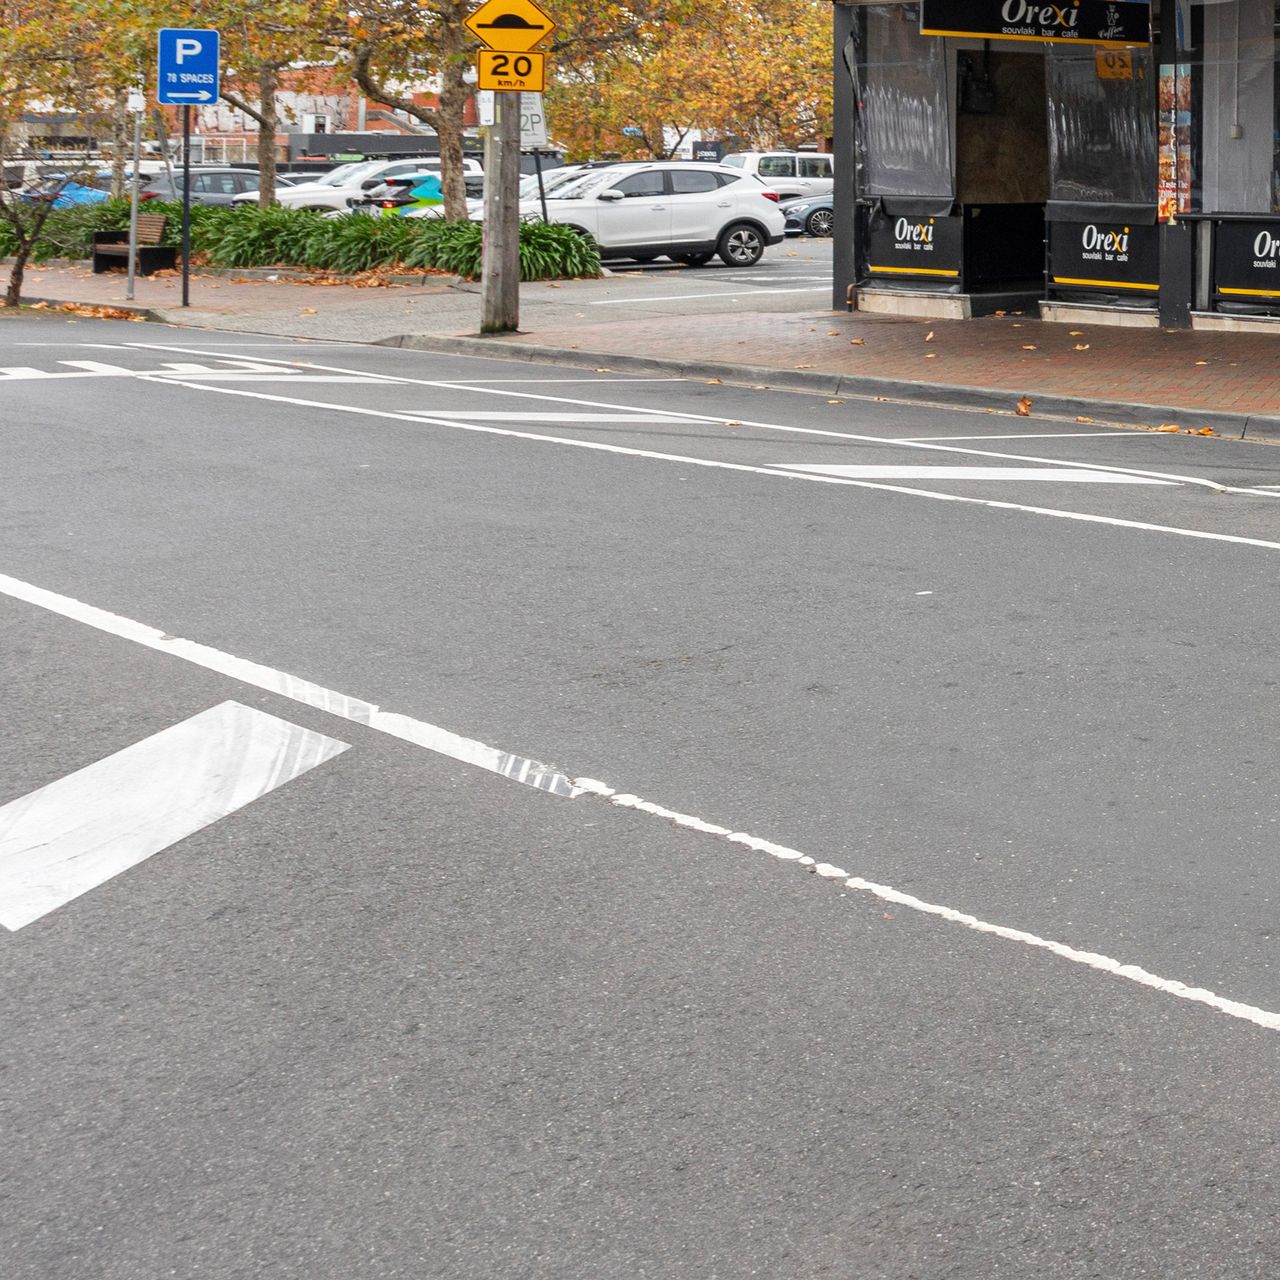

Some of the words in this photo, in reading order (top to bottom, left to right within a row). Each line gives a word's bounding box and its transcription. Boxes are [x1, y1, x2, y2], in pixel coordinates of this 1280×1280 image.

[1002, 26, 1035, 36] souvlaki
[1041, 28, 1055, 37] bar
[1061, 29, 1079, 38] café
[176, 39, 203, 65] P
[491, 55, 532, 77] 20
[179, 73, 215, 84] SPACES
[520, 114, 542, 132] 2P
[895, 217, 934, 242] Orexi
[1082, 225, 1129, 253] Orexi
[1105, 253, 1113, 261] bar
[1253, 259, 1276, 268] souvlaki
